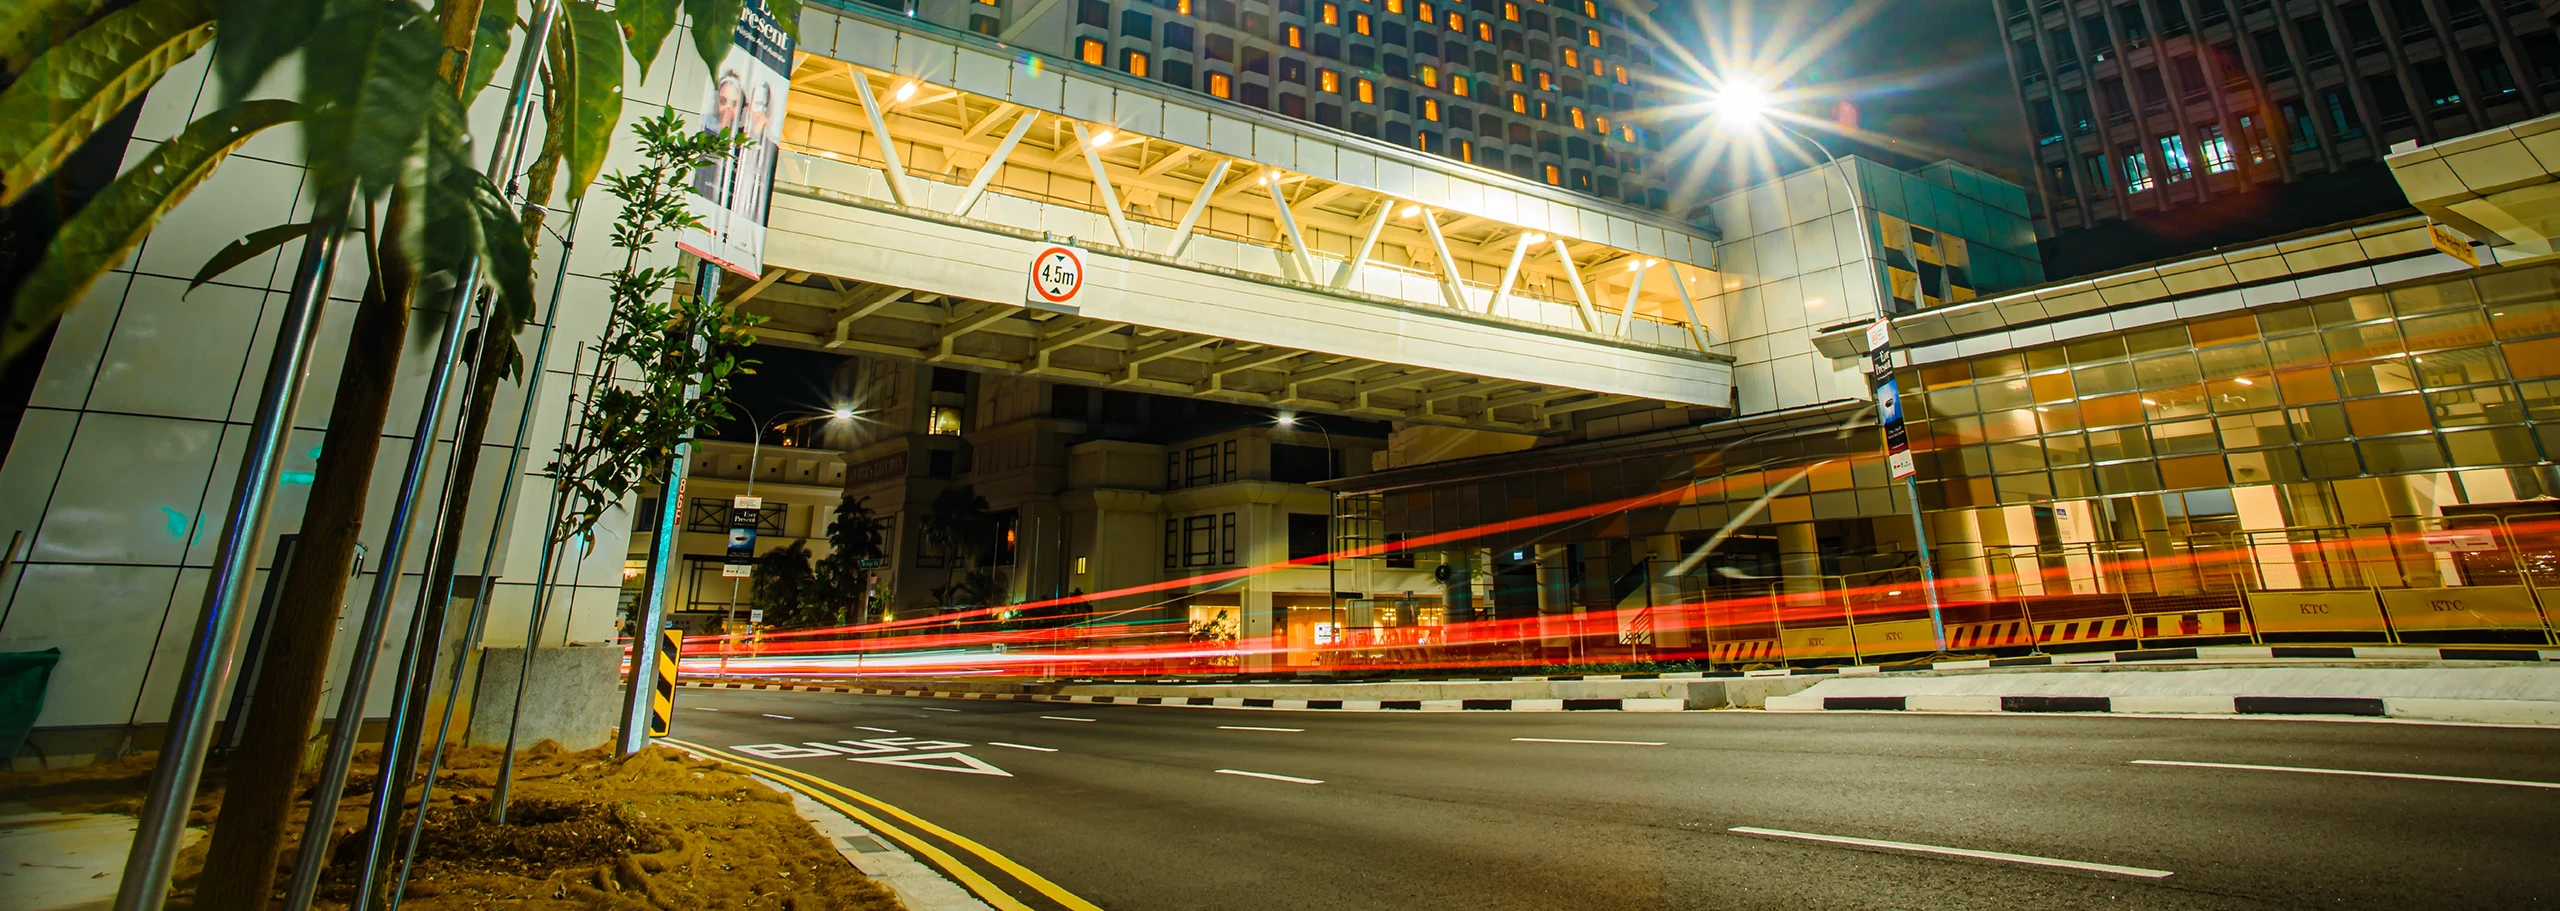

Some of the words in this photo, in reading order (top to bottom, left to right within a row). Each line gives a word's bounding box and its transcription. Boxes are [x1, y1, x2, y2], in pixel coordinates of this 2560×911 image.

[740, 6, 788, 50] resent
[1042, 264, 1074, 286] 4.5m
[2300, 604, 2329, 614] KTC
[2430, 600, 2464, 611] KTC
[1808, 637, 1825, 646] KTC
[1885, 632, 1903, 640] KTC
[729, 737, 973, 760] BUS
